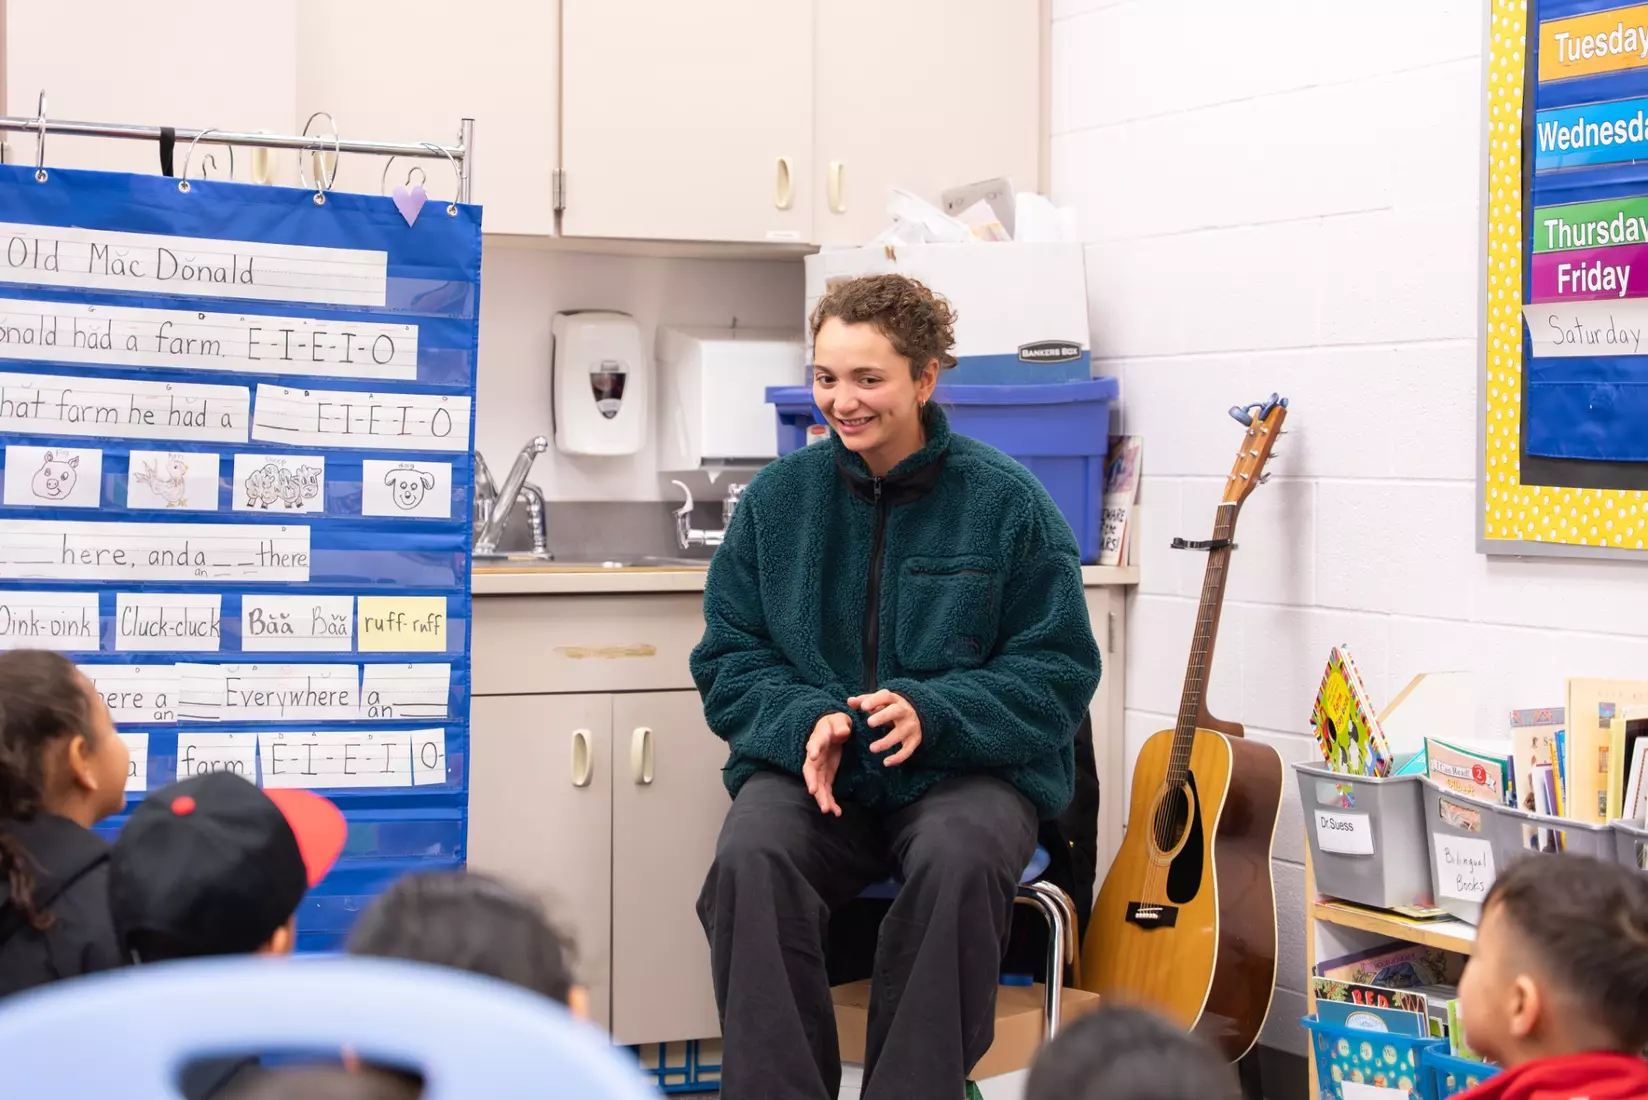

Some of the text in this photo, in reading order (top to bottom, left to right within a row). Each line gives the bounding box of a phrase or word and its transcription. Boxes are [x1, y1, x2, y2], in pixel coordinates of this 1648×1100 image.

[1554, 21, 1648, 63] Tuesday
[1537, 110, 1648, 152] Wednesd
[7, 236, 59, 273] Old
[1558, 260, 1631, 298] Friday
[125, 334, 138, 352] a
[248, 327, 395, 365] E-I-E-I-O
[1548, 314, 1641, 354] Saturday
[1021, 347, 1078, 358] BANKERS BOX
[56, 389, 119, 424] farm
[128, 393, 155, 425] he
[220, 412, 233, 428] a
[61, 533, 136, 568] here,
[148, 540, 189, 566] and
[0, 604, 91, 636] Oink-oink
[121, 605, 221, 638] Cluck-cluck
[154, 693, 167, 709] a
[225, 675, 349, 717] Everywhere
[367, 690, 380, 705] a
[367, 704, 393, 718] an
[153, 710, 174, 721] an
[1444, 847, 1487, 874] Bilingual
[1456, 875, 1485, 892] Books
[1352, 988, 1390, 1009] RED
